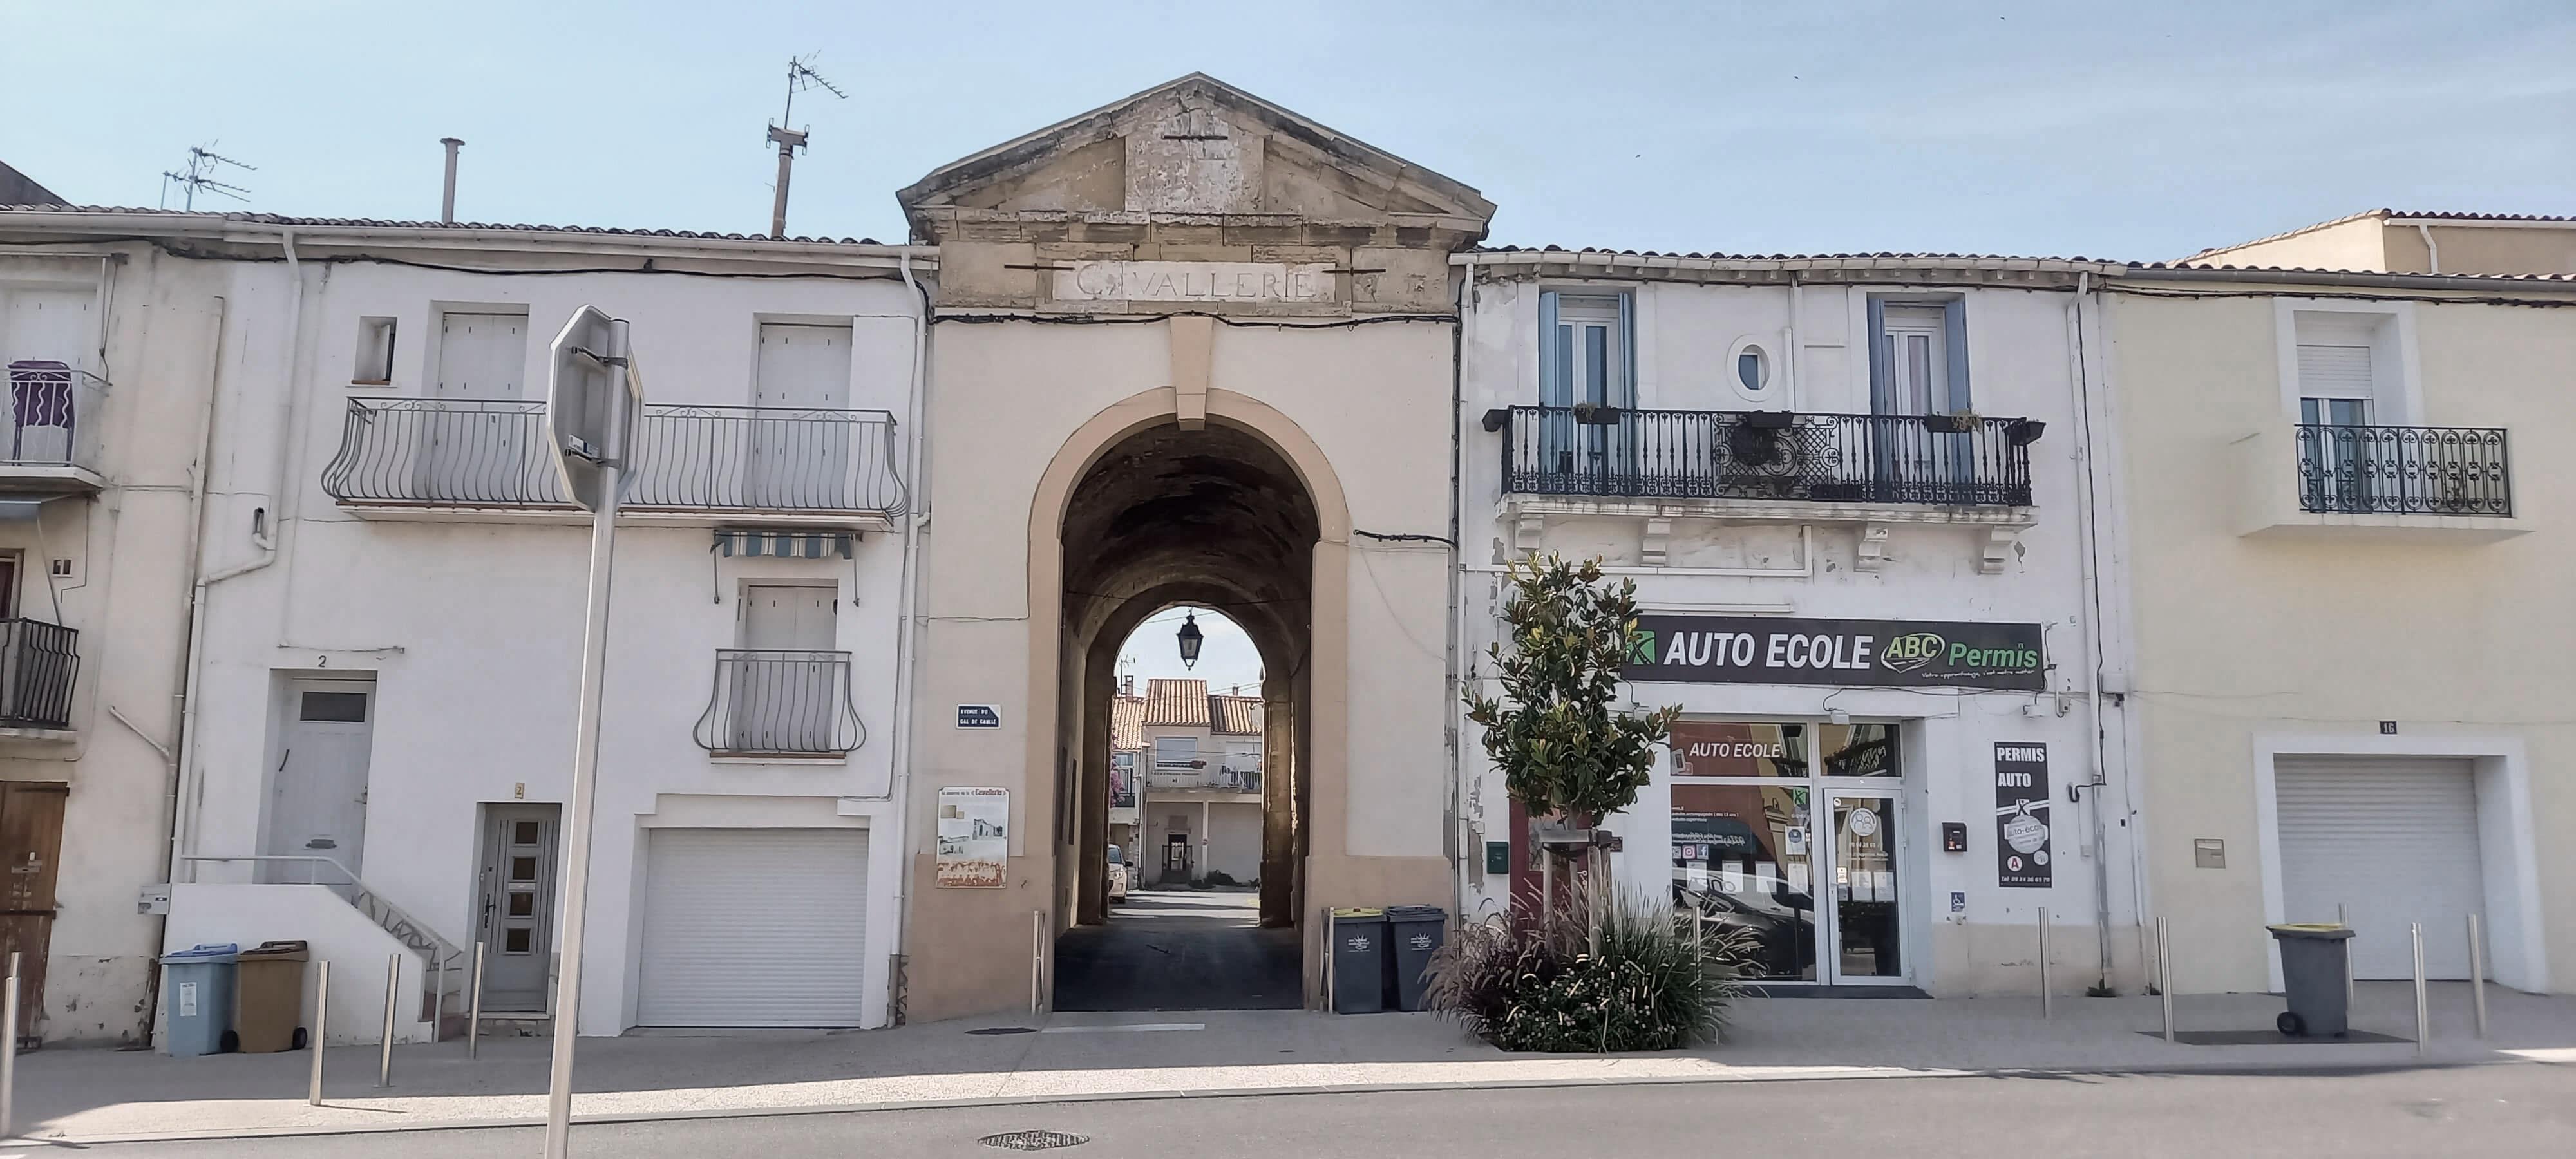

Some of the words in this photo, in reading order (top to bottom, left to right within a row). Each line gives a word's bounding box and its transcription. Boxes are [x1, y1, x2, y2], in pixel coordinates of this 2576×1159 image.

[1663, 632, 1755, 667] AUTO
[1765, 634, 1874, 670] ECOLE
[1886, 636, 1938, 659] ABC
[1948, 643, 2038, 668] Permis
[318, 655, 326, 668] 2
[1689, 742, 1729, 757] AUTO
[1733, 743, 1781, 758] ECOLE
[1996, 747, 2045, 762] PERMIS
[1998, 772, 2032, 787] AUTO
[2011, 857, 2020, 869] A
